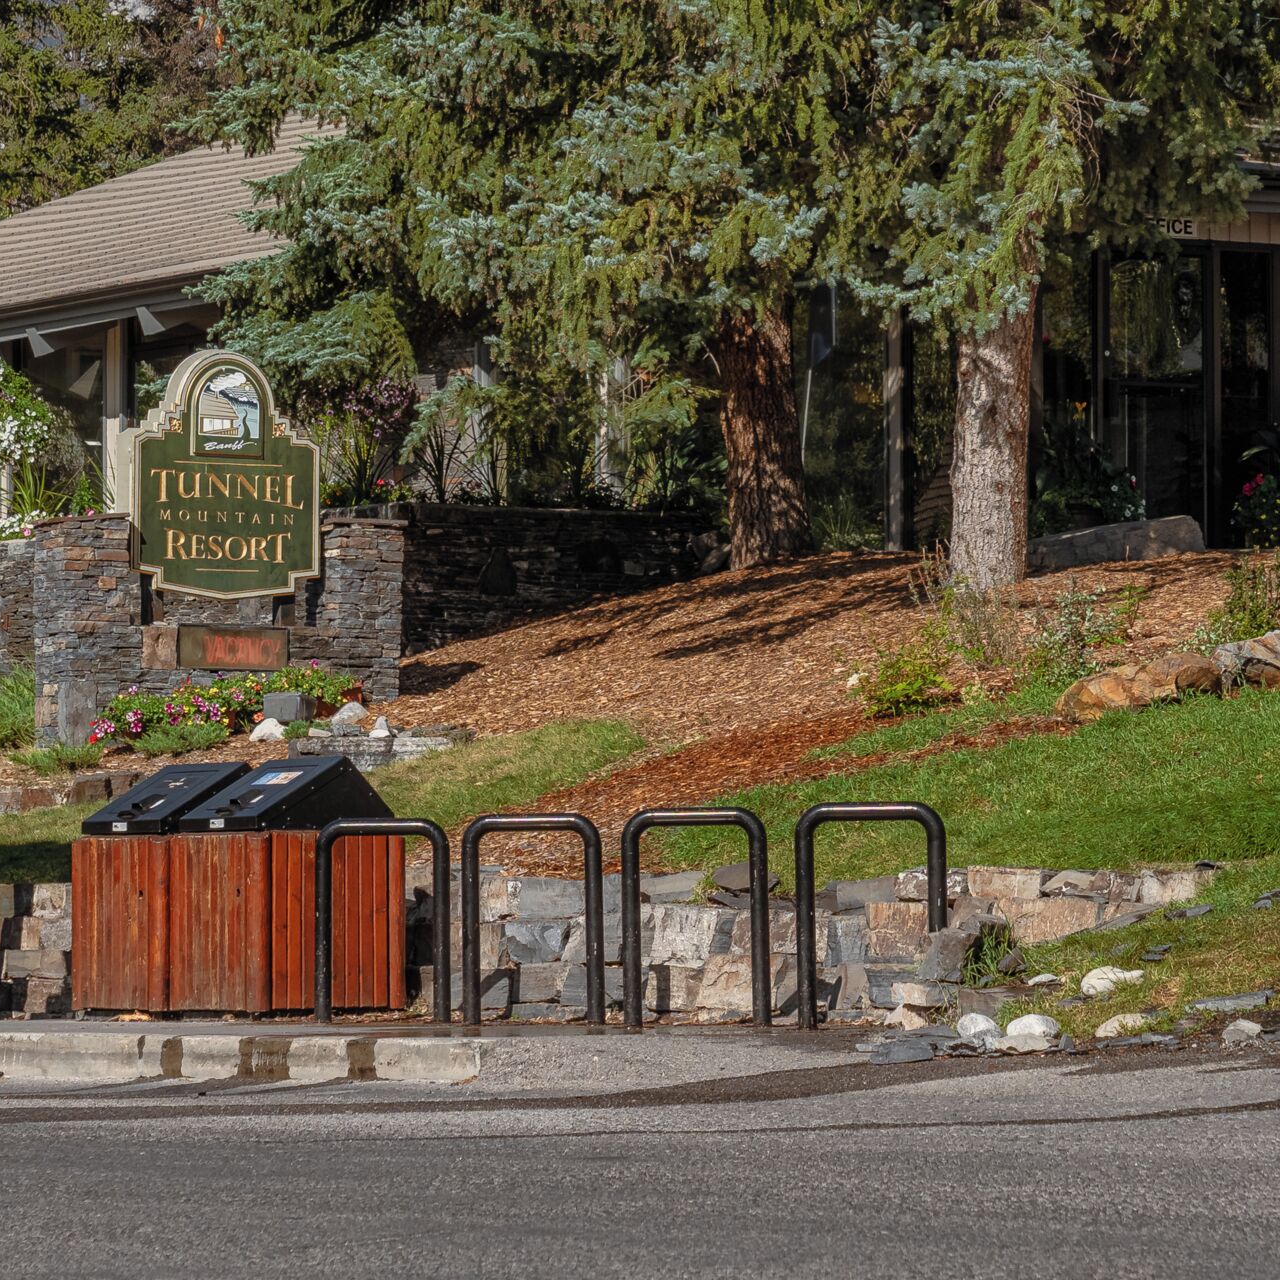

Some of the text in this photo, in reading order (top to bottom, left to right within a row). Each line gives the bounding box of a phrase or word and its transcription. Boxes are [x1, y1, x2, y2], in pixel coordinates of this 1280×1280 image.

[203, 439, 255, 451] Banff
[150, 468, 305, 510] TUNNEL
[159, 509, 294, 525] MOUNTAIN
[163, 527, 291, 564] RESORT
[203, 634, 281, 667] VACANCY
